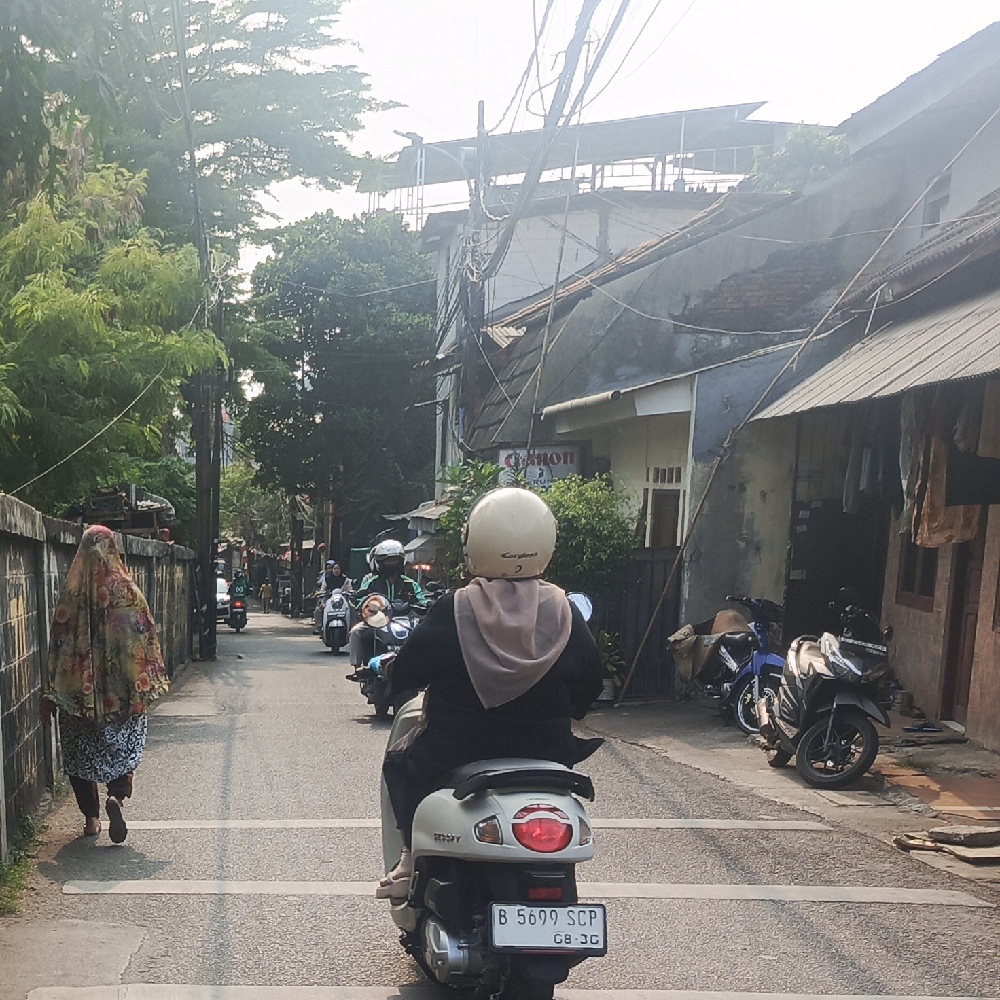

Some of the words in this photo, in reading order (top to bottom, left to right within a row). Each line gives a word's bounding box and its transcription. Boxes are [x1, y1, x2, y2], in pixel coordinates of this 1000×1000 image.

[504, 451, 575, 468] Canon
[498, 908, 508, 925] B
[517, 908, 558, 926] 5699
[566, 909, 597, 927] SCP
